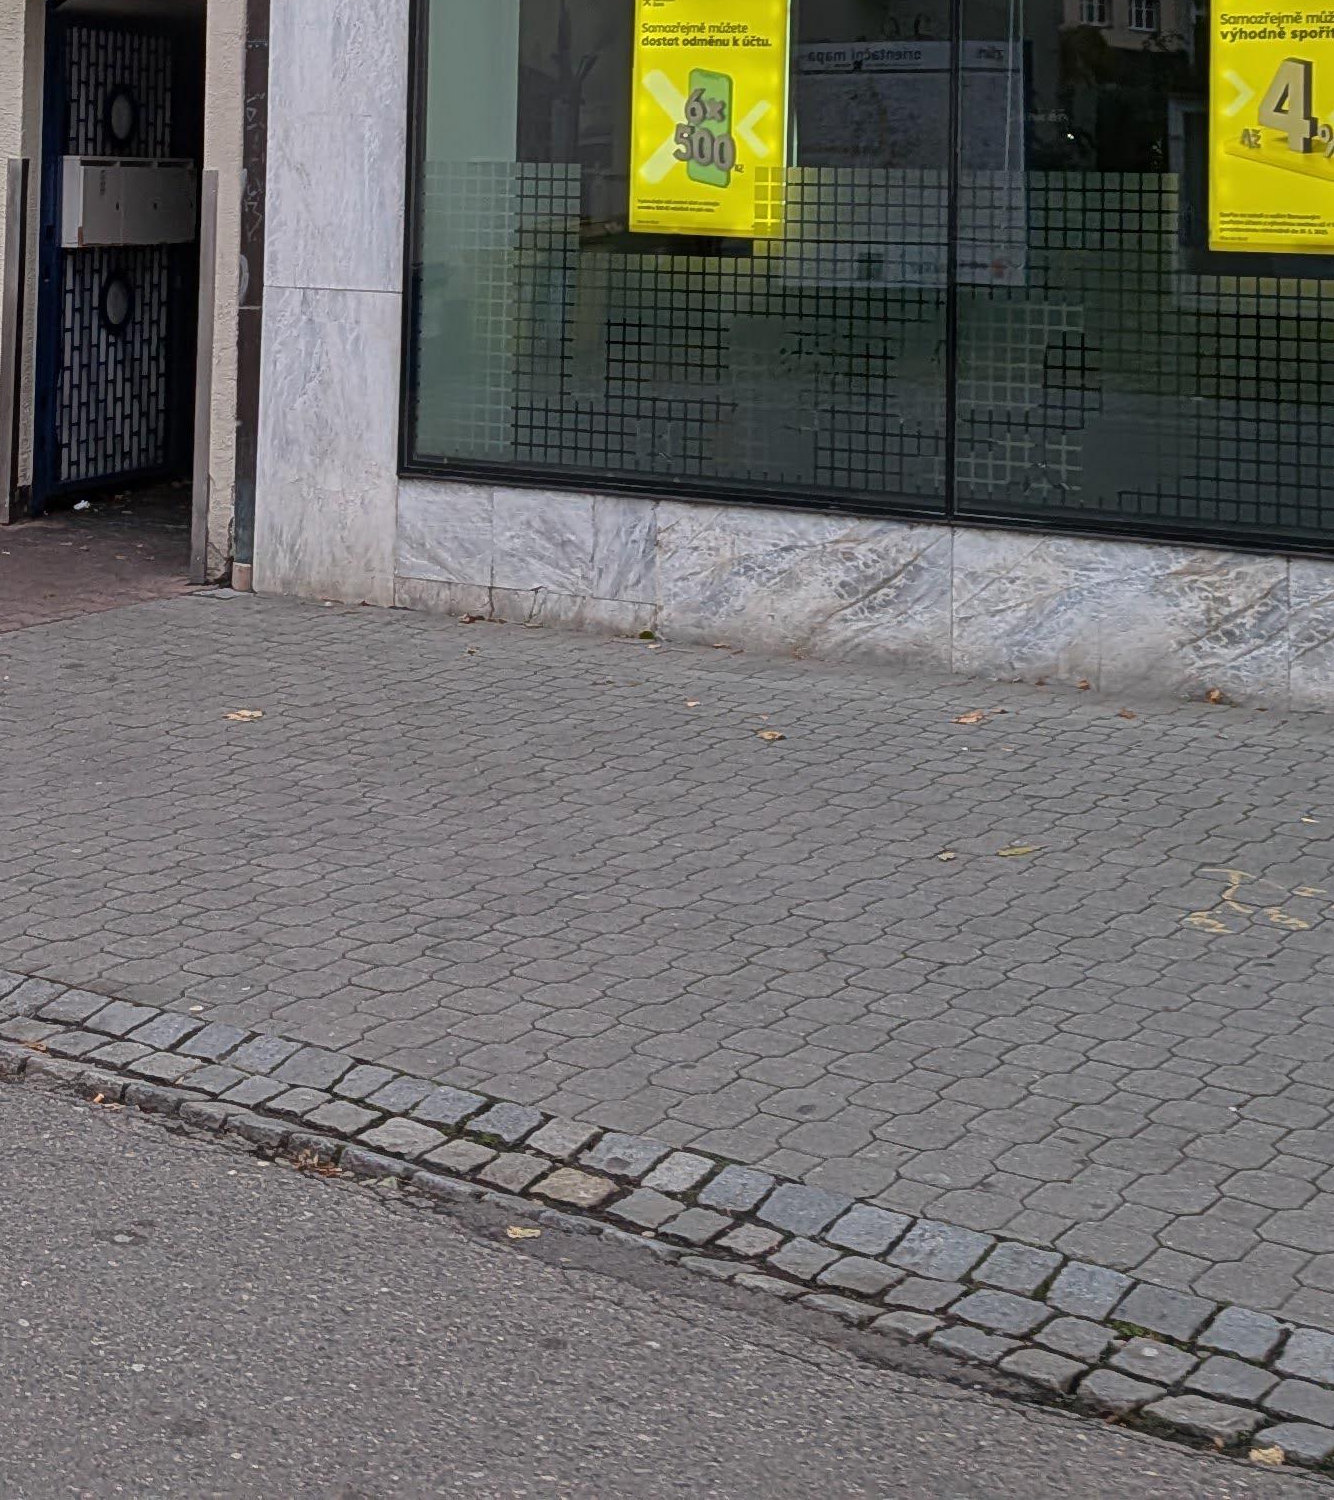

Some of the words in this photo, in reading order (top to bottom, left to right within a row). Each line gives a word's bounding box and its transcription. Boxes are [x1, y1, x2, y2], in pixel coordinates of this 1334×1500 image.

[1220, 12, 1303, 27] Samozřejmě
[641, 22, 706, 36] Samozřejmě
[708, 22, 749, 34] můžete
[1220, 27, 1286, 43] výhodně
[641, 36, 680, 47] dostat
[682, 36, 730, 47] odměnu
[732, 36, 740, 46] k
[742, 36, 772, 47] účtu.
[1258, 57, 1318, 154] 4
[673, 122, 737, 171] 500
